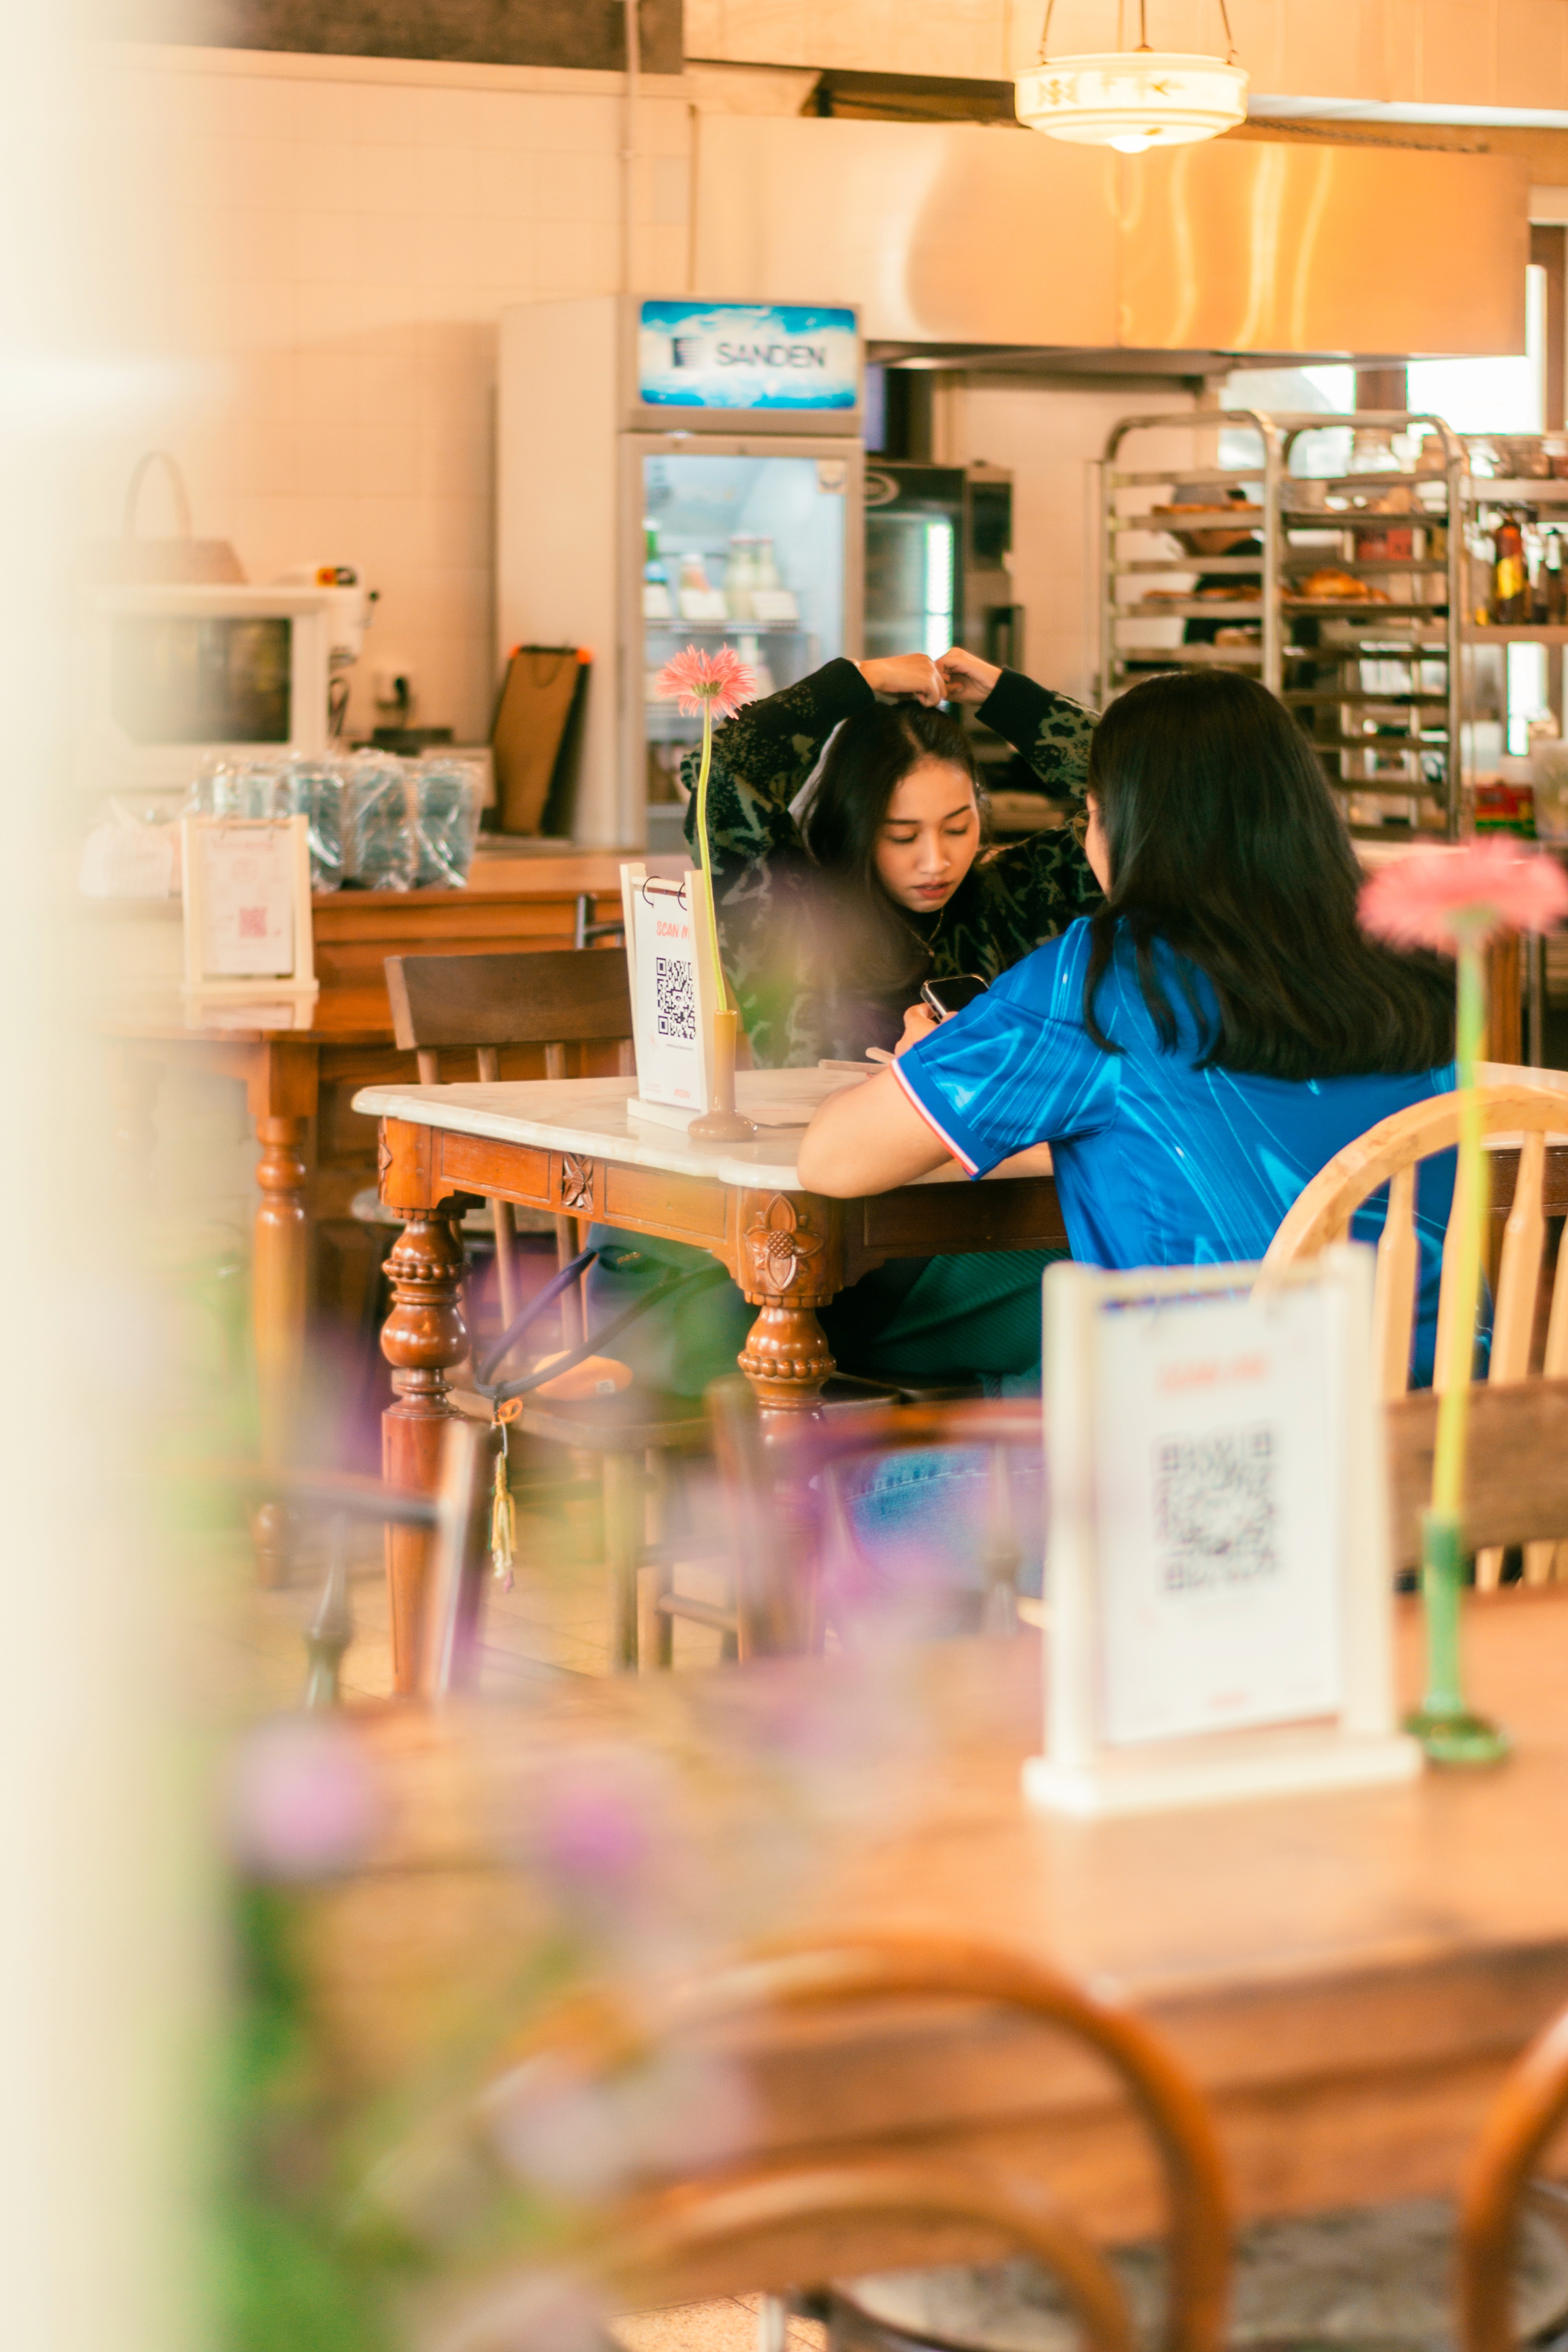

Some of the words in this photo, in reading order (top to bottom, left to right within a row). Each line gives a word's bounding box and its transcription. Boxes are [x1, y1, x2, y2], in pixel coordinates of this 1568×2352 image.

[716, 342, 826, 368] SANDEN
[657, 920, 679, 938] SCAN
[681, 925, 690, 940] M
